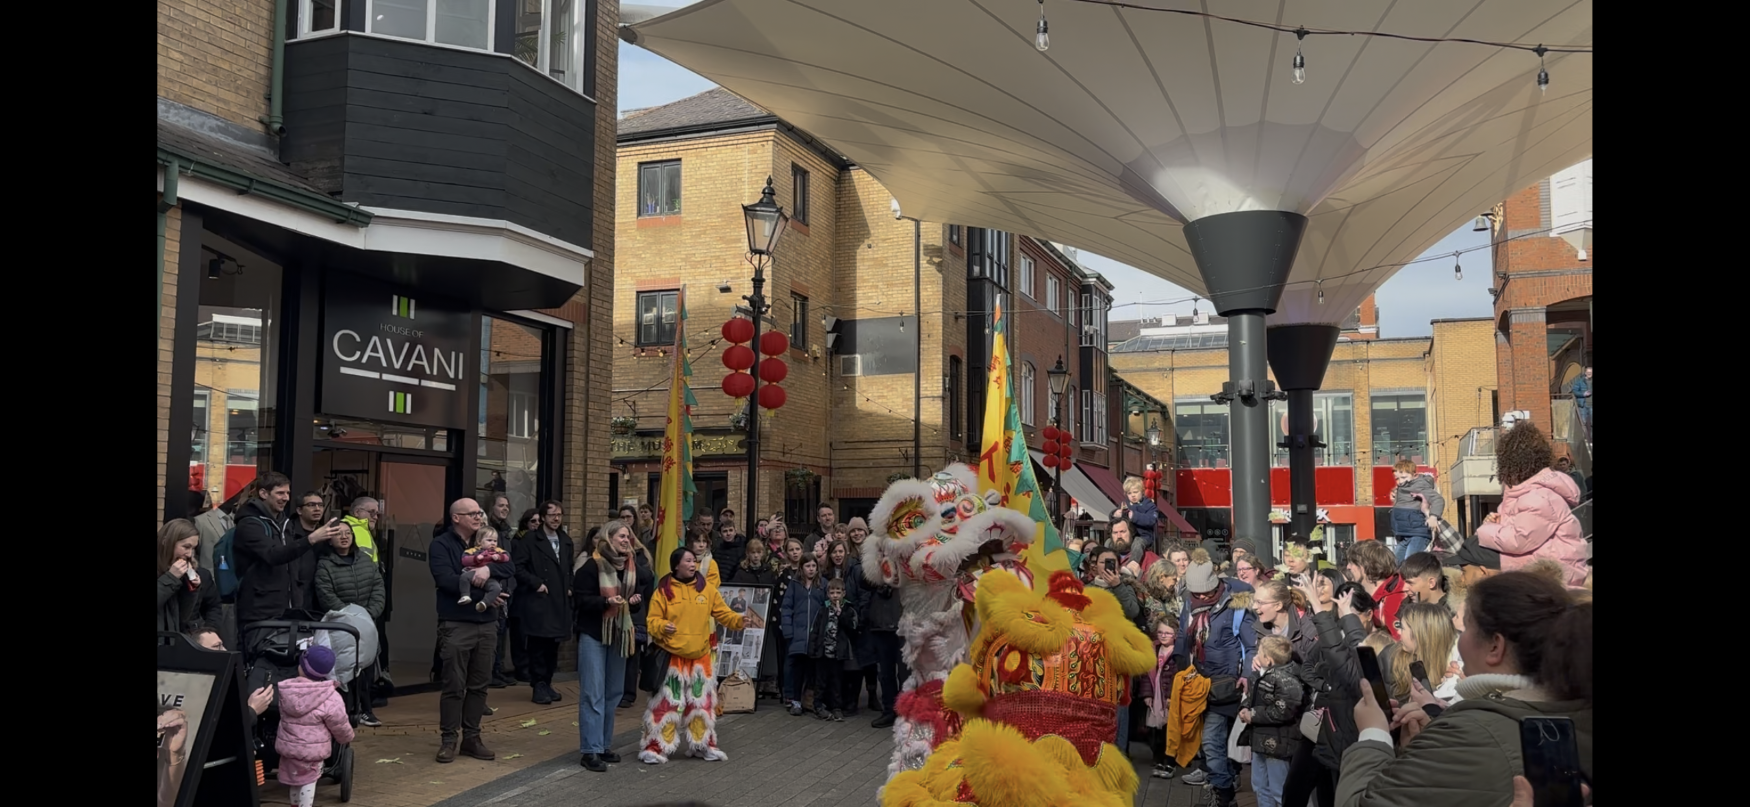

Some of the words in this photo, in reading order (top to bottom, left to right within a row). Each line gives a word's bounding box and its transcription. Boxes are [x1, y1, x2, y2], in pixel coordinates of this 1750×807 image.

[380, 323, 411, 336] HOUSE
[411, 330, 424, 338] OF
[332, 329, 464, 380] CAVANI
[640, 439, 702, 453] MUM
